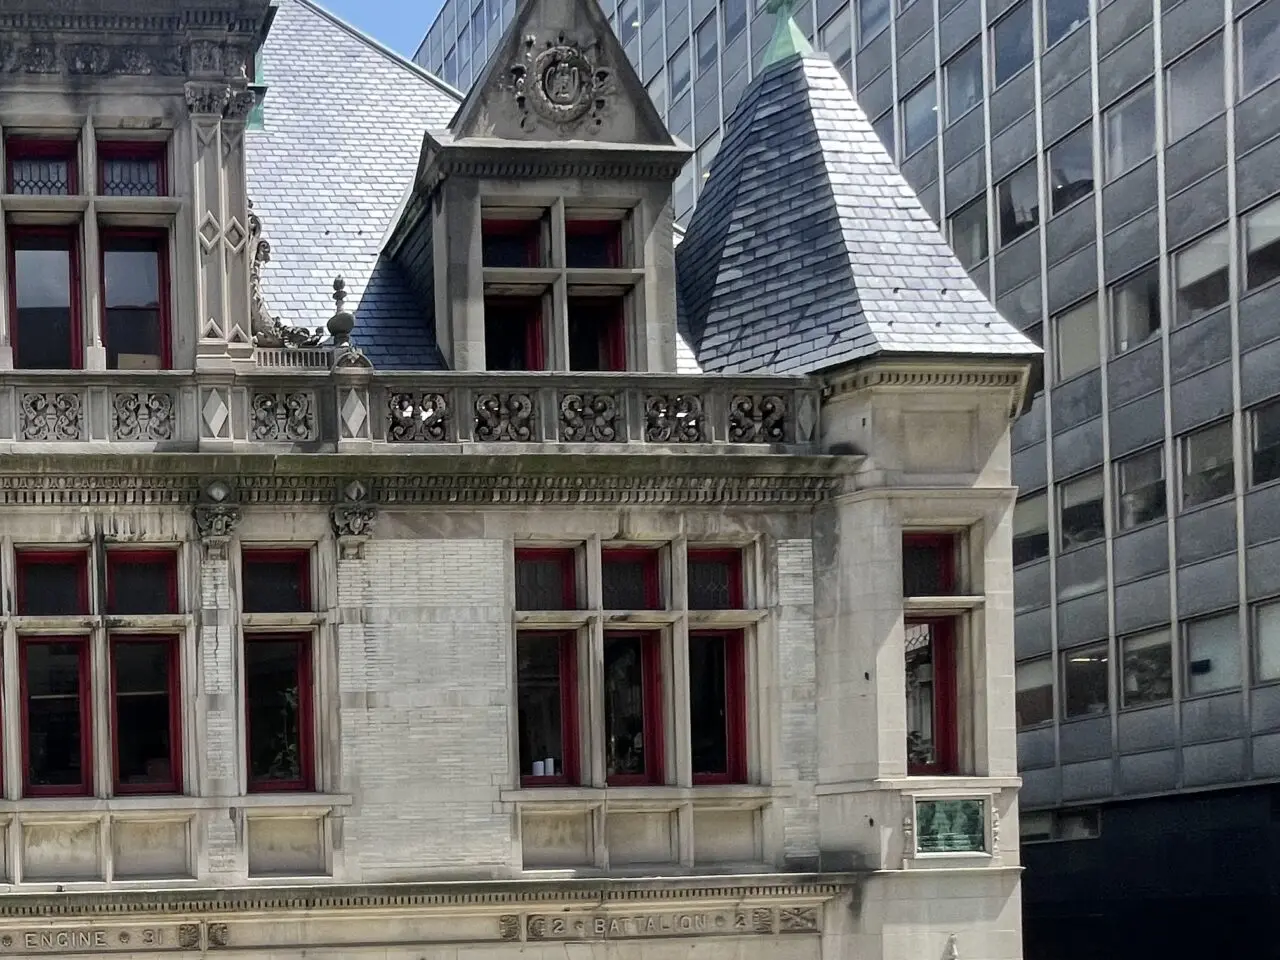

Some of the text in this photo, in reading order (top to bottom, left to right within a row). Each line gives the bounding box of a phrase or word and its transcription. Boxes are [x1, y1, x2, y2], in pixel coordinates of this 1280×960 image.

[551, 917, 566, 934] 2
[593, 914, 707, 935] BATTALION
[24, 930, 108, 949] ENGINE
[142, 928, 164, 945] 31
